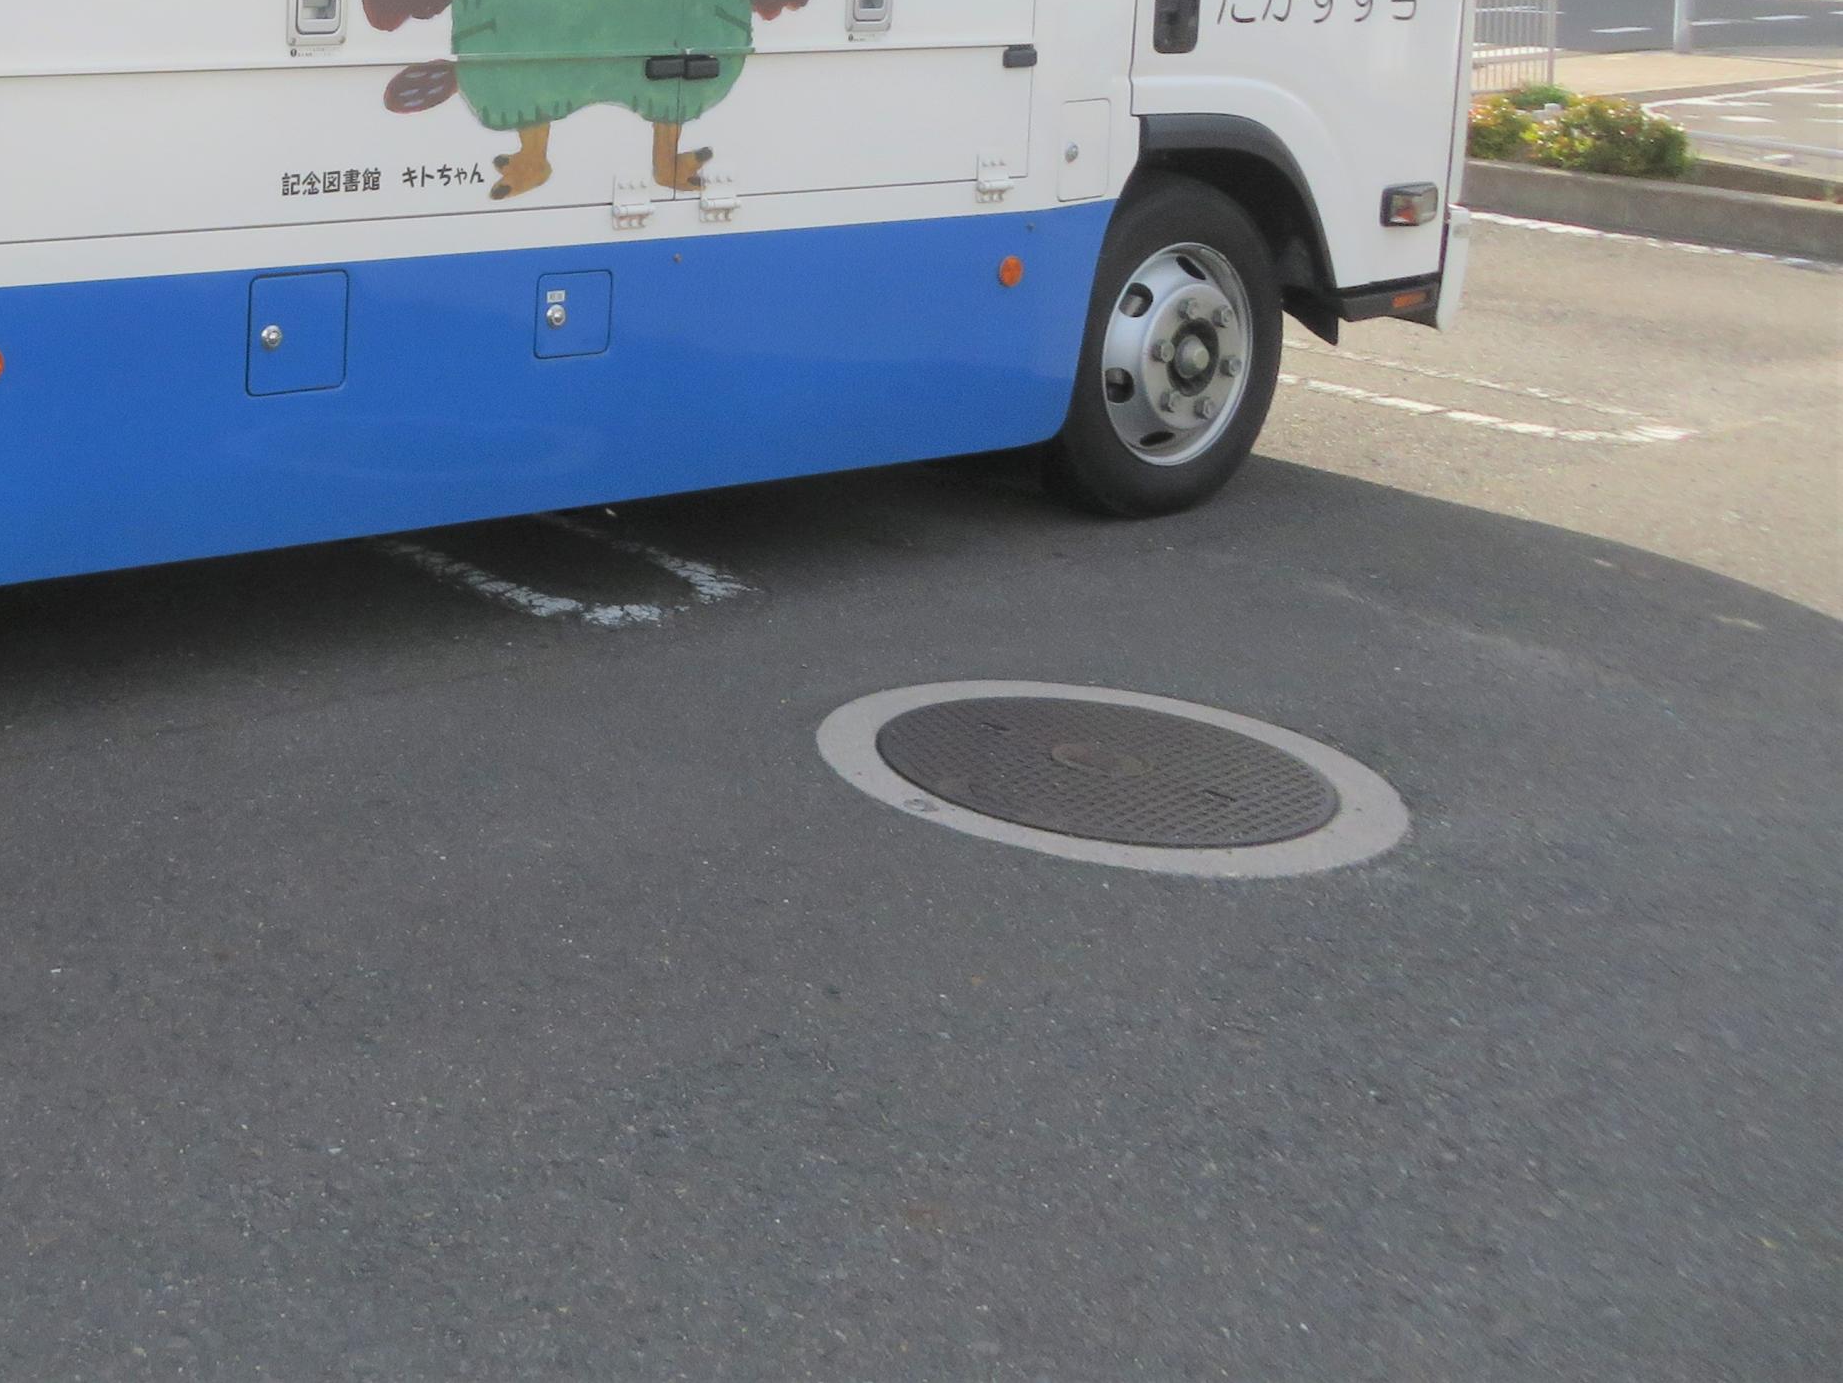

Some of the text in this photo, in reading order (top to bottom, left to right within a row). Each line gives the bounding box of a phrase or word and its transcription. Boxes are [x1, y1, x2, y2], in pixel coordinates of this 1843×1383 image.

[281, 162, 485, 196] 記念図書館 キトちゃん
